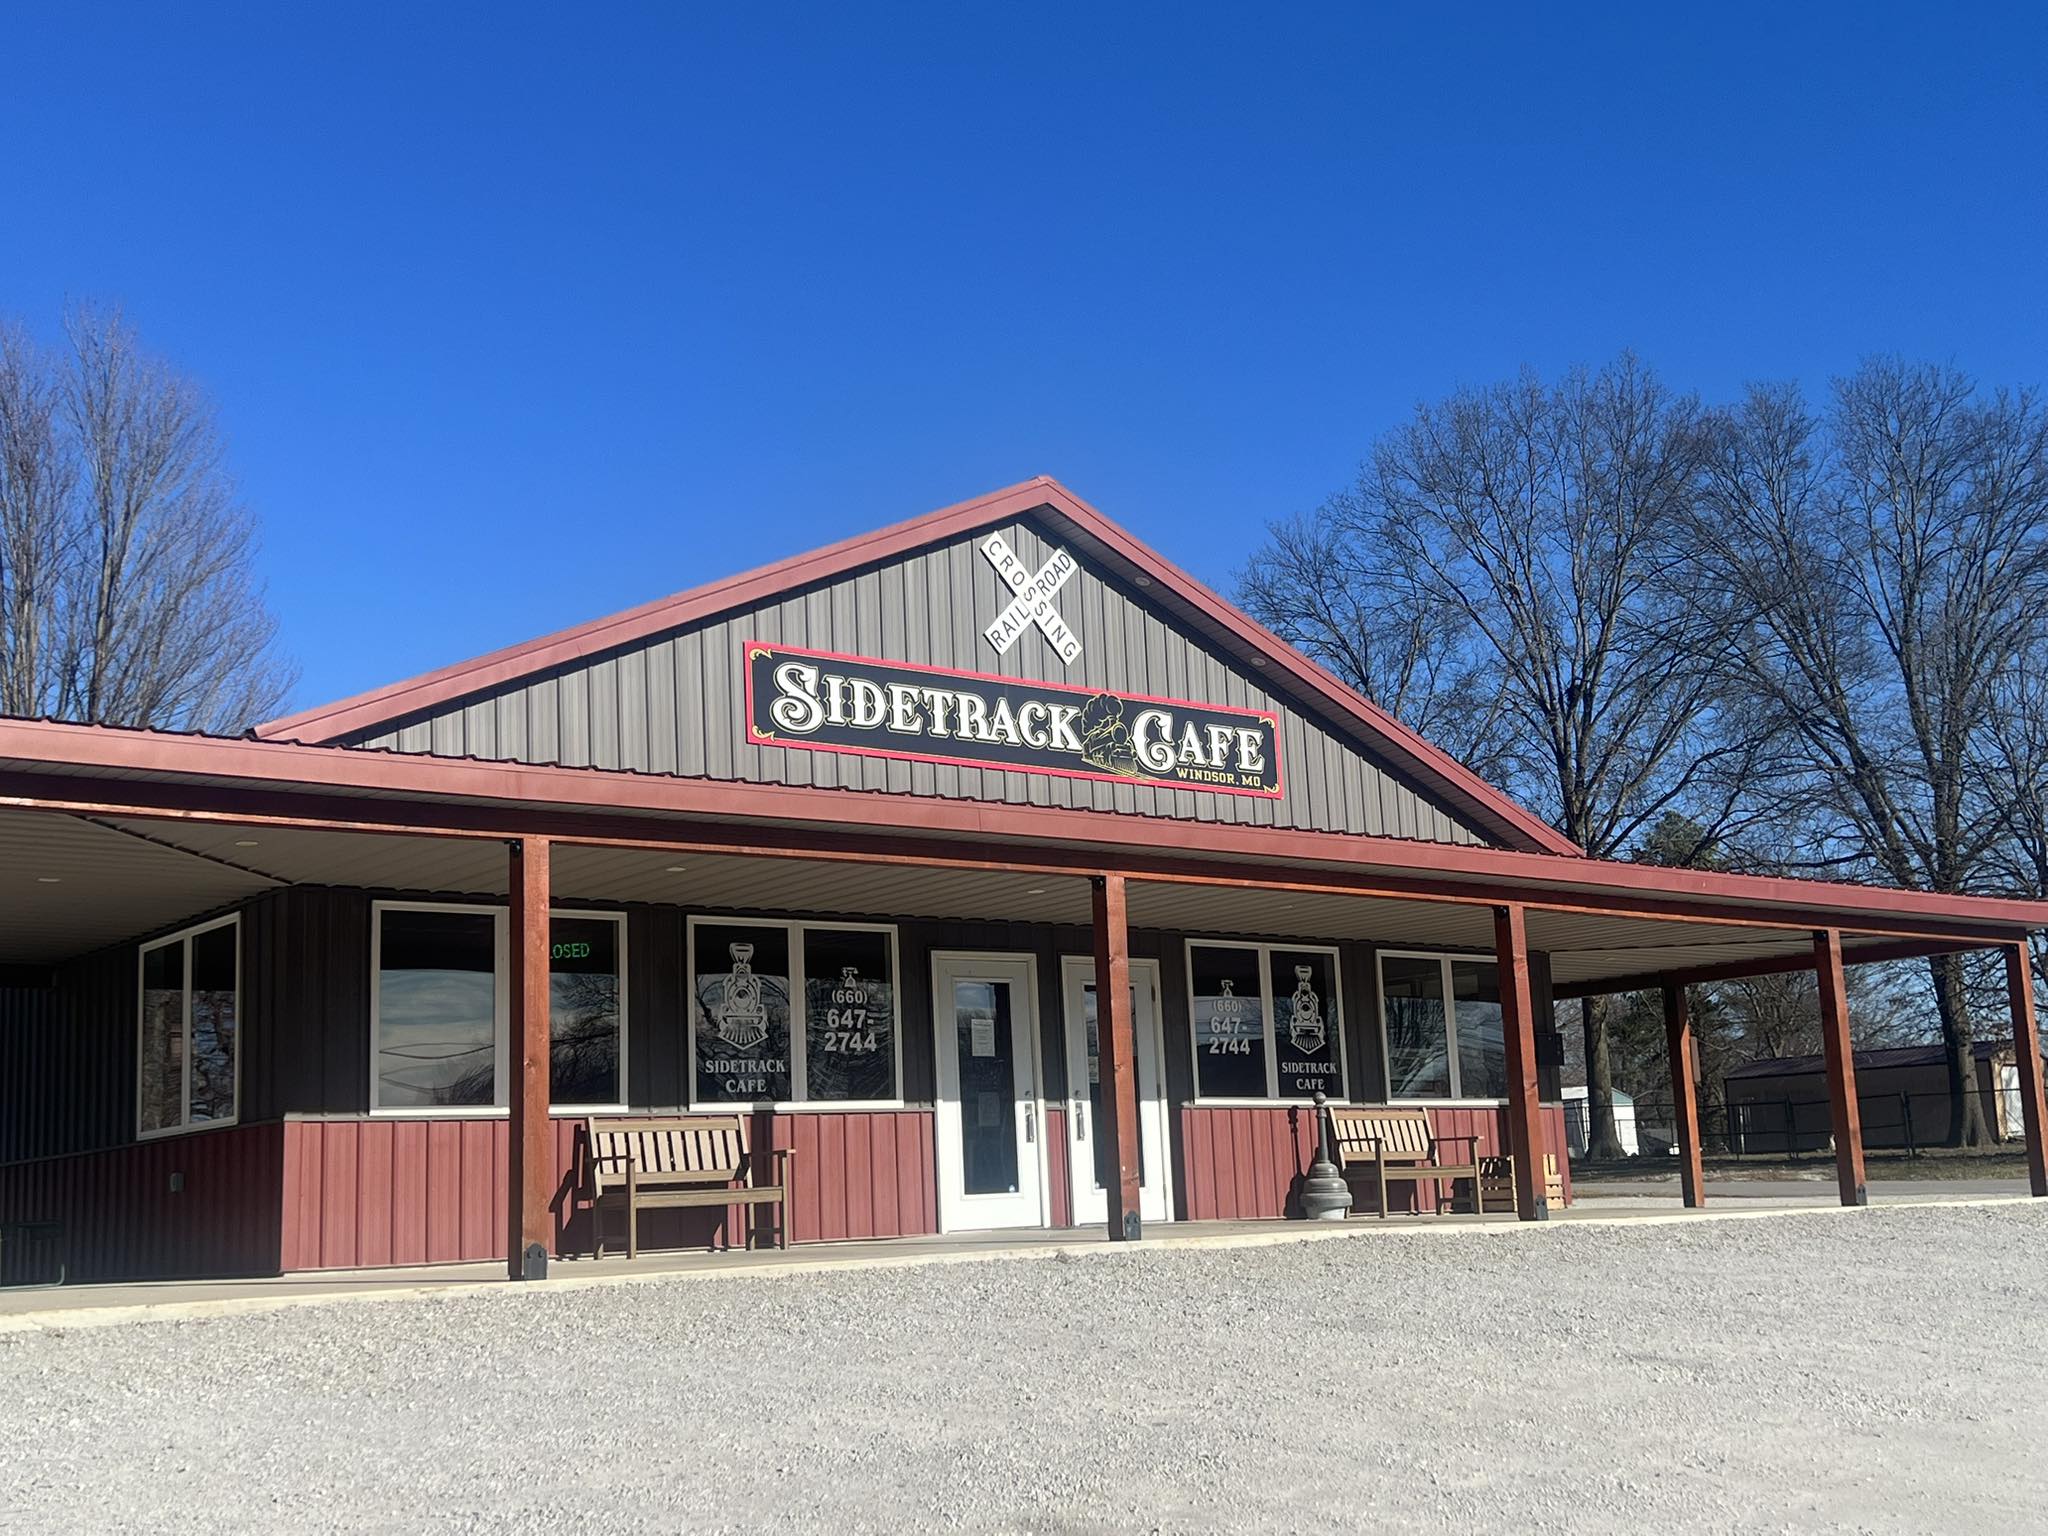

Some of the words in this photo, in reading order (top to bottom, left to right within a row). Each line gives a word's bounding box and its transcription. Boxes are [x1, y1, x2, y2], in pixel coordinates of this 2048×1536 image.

[989, 541, 1076, 658] CROSSING
[769, 661, 1084, 752] SIDETRACK
[1131, 709, 1265, 774] CAFE
[1241, 774, 1261, 787] MO
[550, 942, 590, 959] OSED
[831, 990, 868, 1004] (660)
[1213, 1000, 1242, 1013] (660)
[824, 1032, 877, 1052] 2744
[1209, 1037, 1250, 1055] 2744
[705, 1059, 786, 1073] SIDETRACK
[1281, 1062, 1337, 1074] SIDETRACK
[725, 1079, 767, 1093] CAFE
[1296, 1078, 1325, 1090] CAFE
